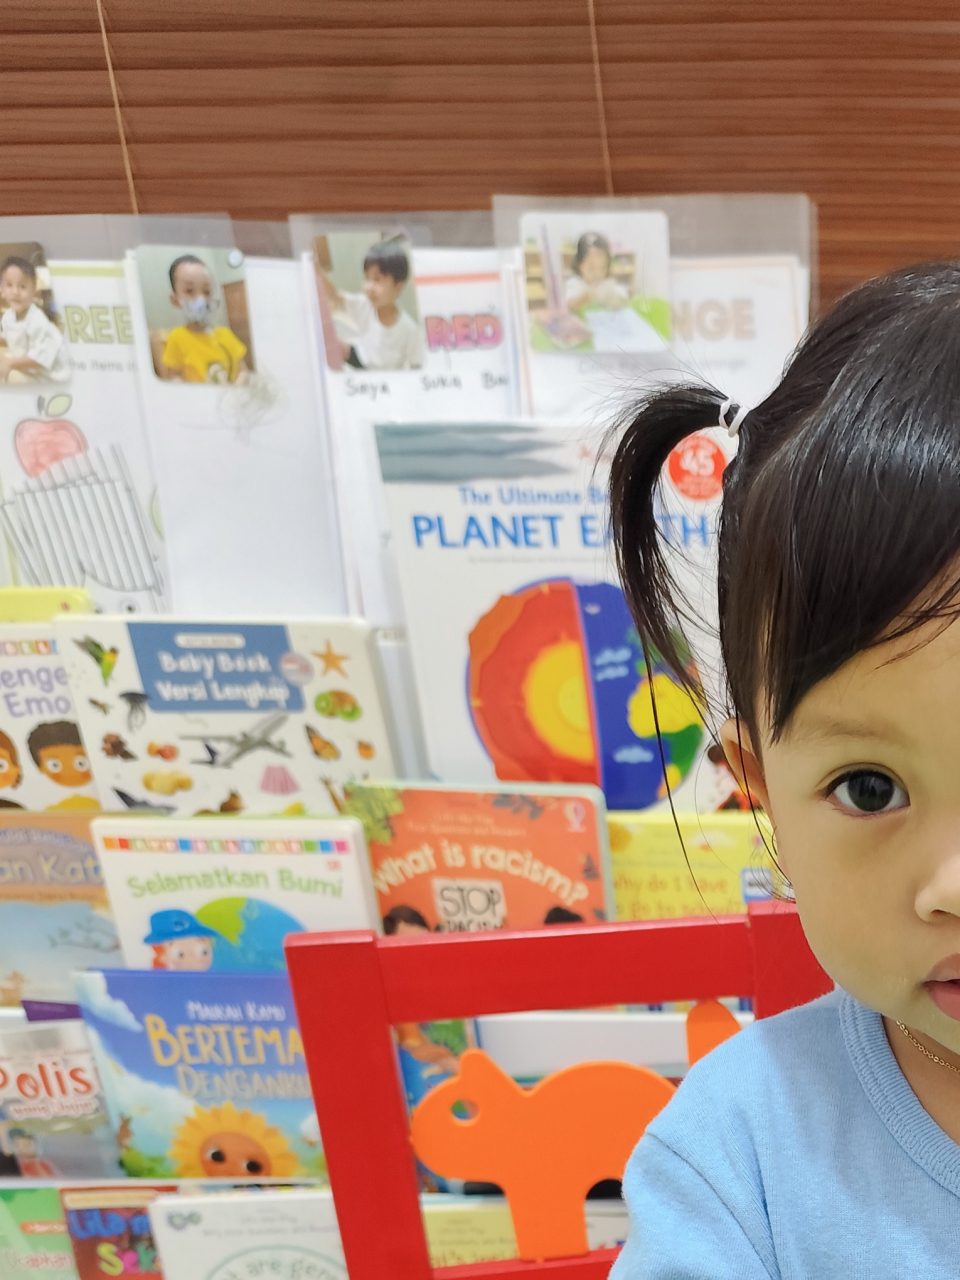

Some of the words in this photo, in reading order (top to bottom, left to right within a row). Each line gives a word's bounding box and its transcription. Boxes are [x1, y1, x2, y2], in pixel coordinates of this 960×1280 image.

[425, 313, 503, 351] RED
[458, 487, 491, 506] The
[499, 487, 582, 506] Ultimate
[412, 515, 563, 549] PLANET
[158, 651, 214, 679] Baby
[216, 652, 273, 673] Book
[3, 692, 72, 718] Emo
[154, 680, 208, 701] Versi
[127, 865, 270, 898] Selamatkan
[279, 868, 343, 897] Bumi
[440, 839, 466, 868] is
[471, 844, 590, 906] racism?
[439, 885, 502, 917] STOP
[248, 1259, 281, 1275] are
